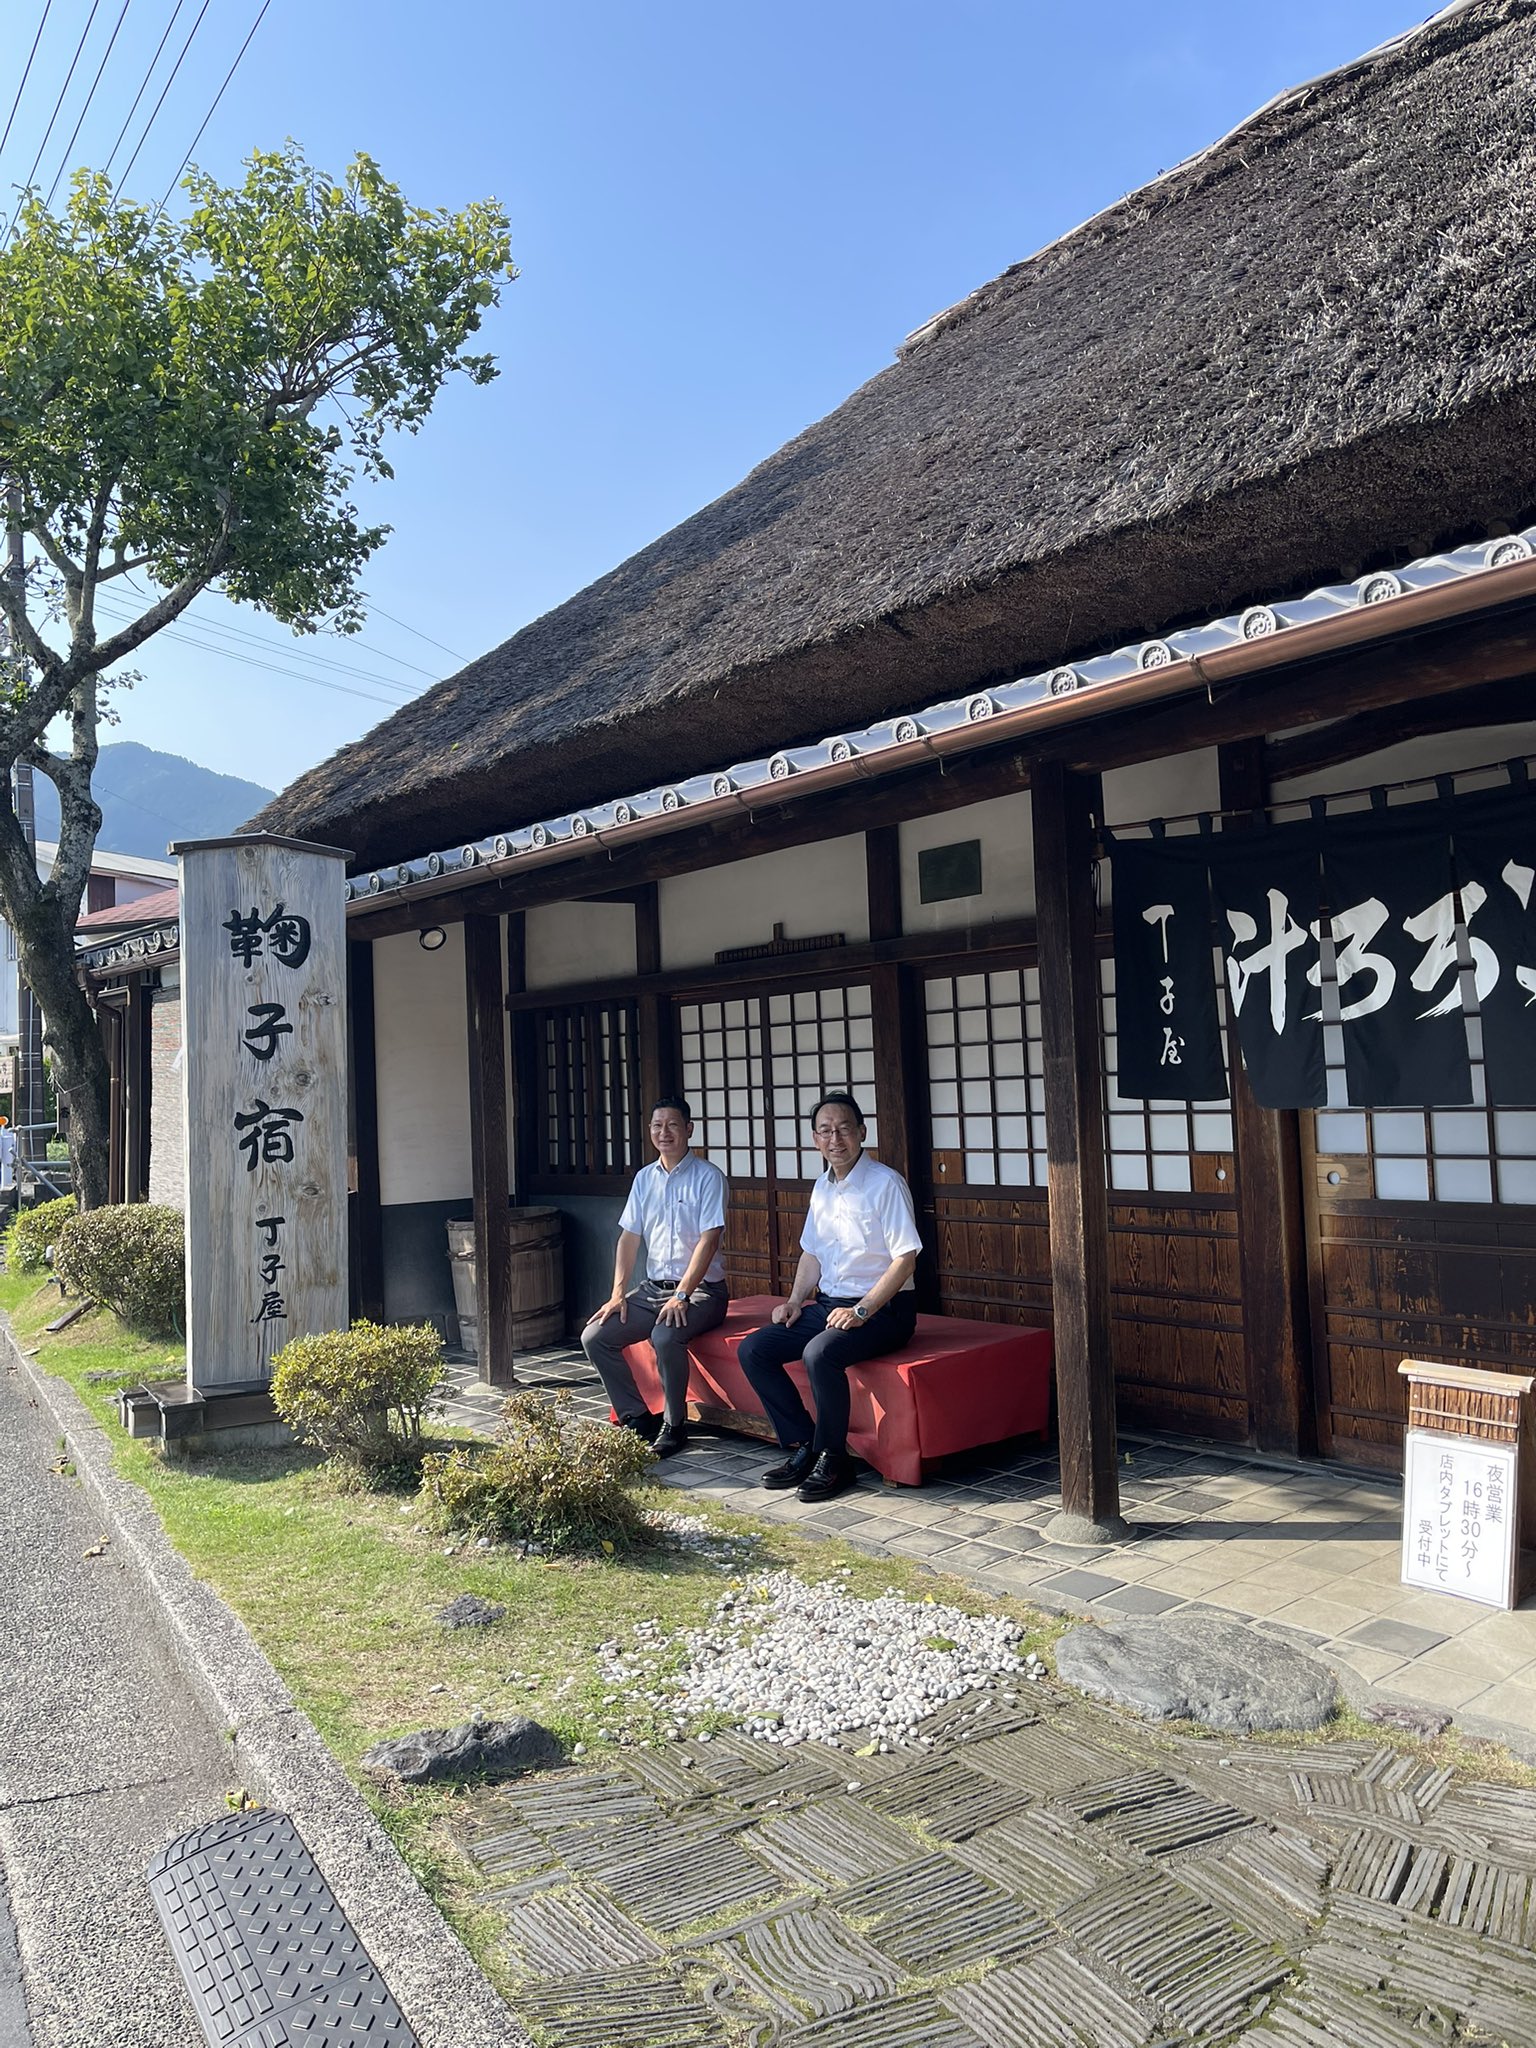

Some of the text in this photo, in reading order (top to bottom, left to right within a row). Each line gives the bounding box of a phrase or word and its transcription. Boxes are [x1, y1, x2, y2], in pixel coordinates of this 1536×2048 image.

[222, 903, 312, 1172] 鞠子宿
[1142, 904, 1187, 1066] 丁子屋
[250, 1216, 288, 1323] 丁子屋
[1417, 1519, 1433, 1567] 受付中
[1436, 1454, 1454, 1582] 店内タブレットにて
[1485, 1464, 1504, 1524] 夜営業
